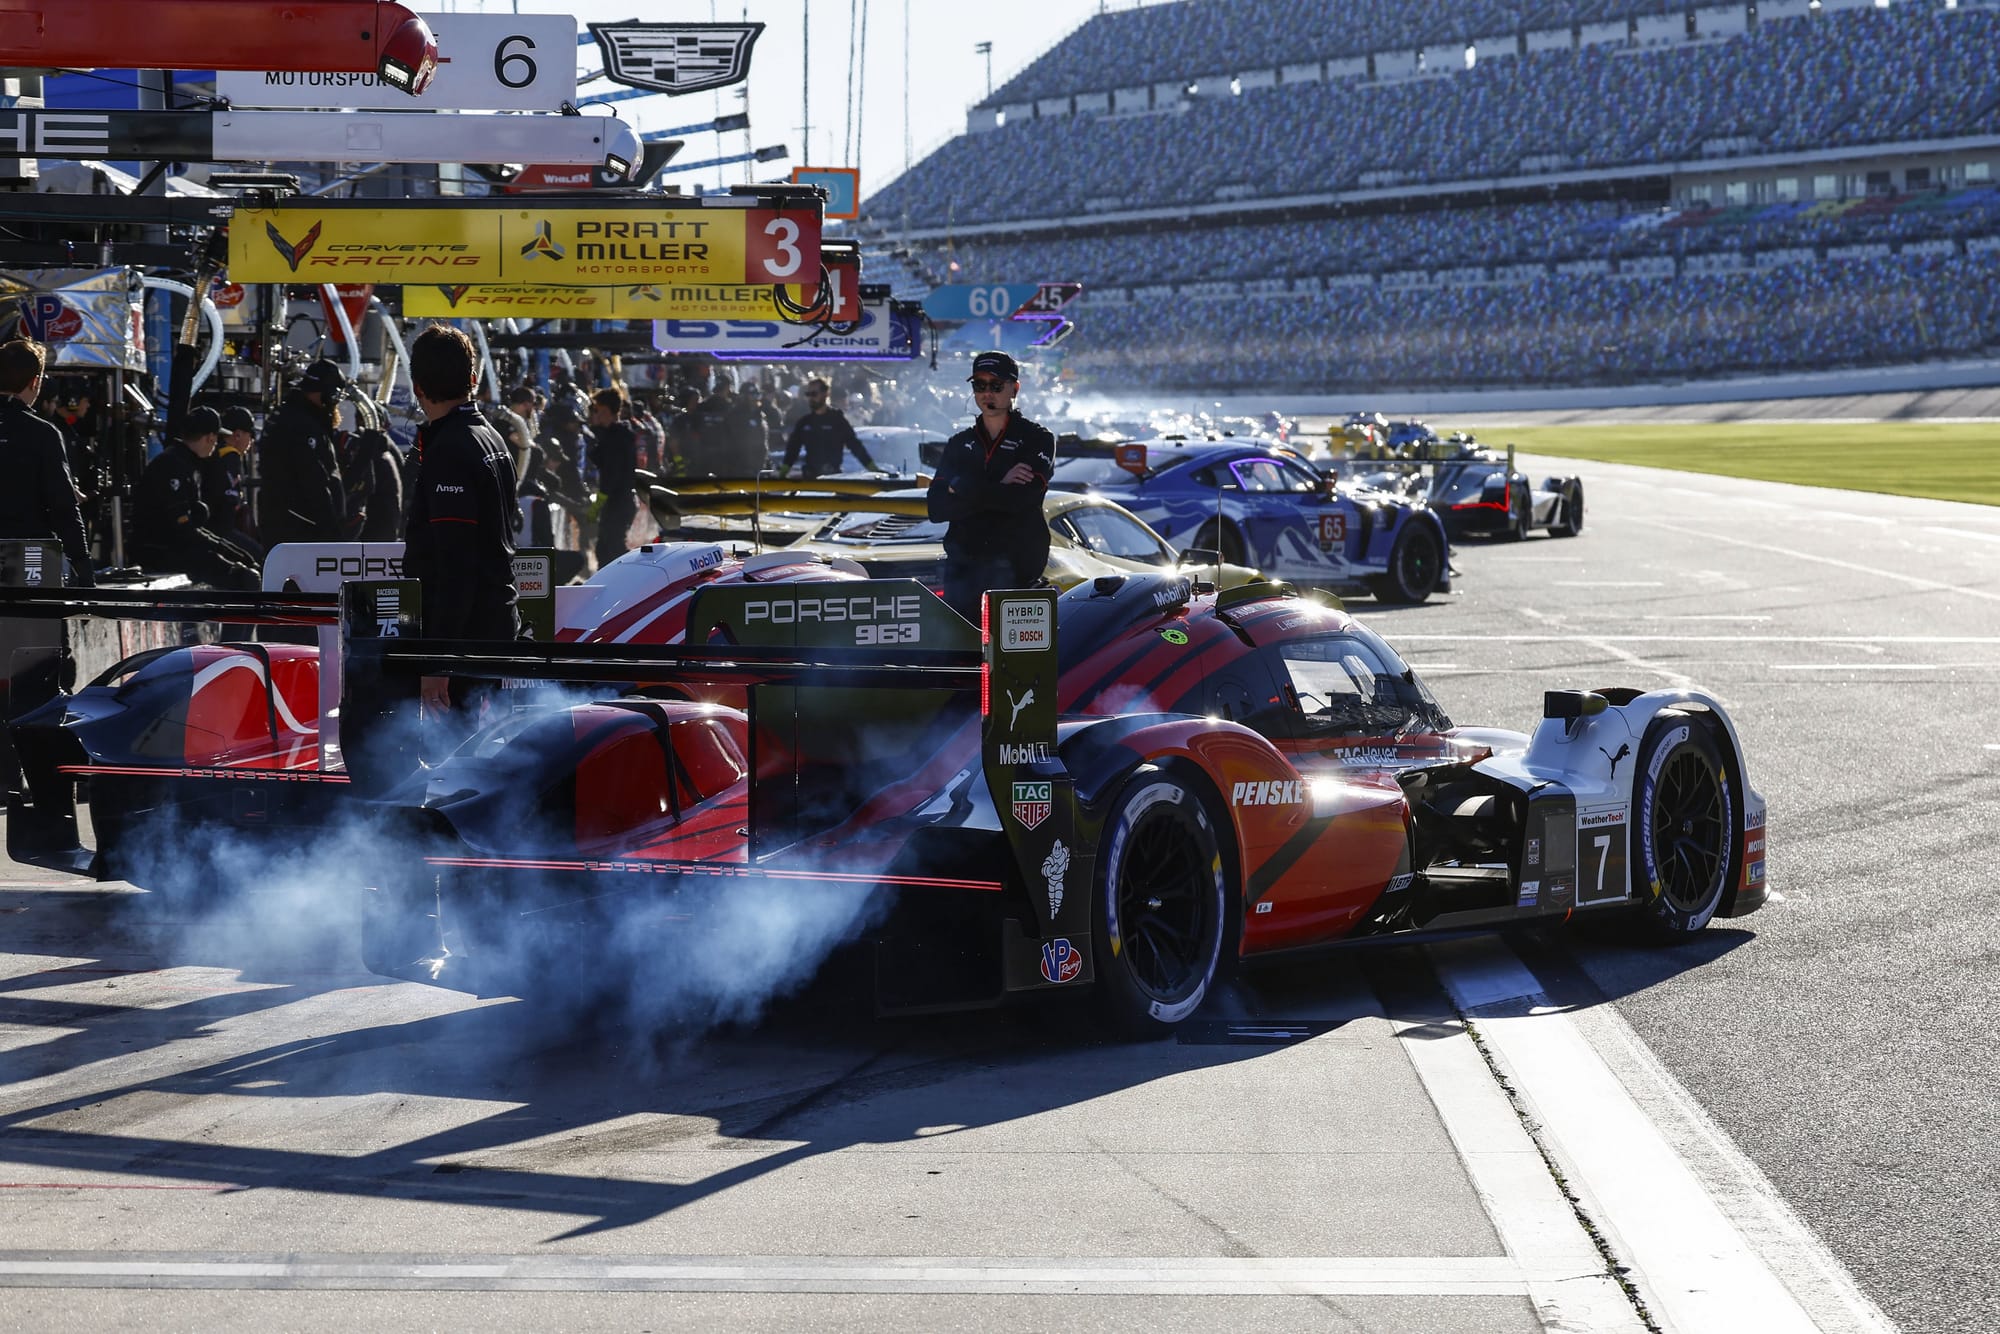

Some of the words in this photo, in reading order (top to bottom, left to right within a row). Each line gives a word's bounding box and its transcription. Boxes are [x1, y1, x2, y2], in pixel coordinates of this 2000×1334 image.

[494, 35, 537, 88] 6
[543, 173, 590, 184] WHELEN
[577, 222, 709, 239] PRATT
[327, 244, 469, 252] CORVETTE
[577, 243, 708, 260] MILLER
[763, 218, 801, 277] 3
[310, 256, 480, 266] RACING
[577, 265, 709, 274] MOTORSPORTS
[479, 287, 589, 295] CORVETTE
[671, 288, 772, 301] MILLER
[812, 269, 846, 314] 4
[1033, 287, 1063, 310] 45
[465, 296, 597, 306] RACING
[671, 304, 774, 312] MOTORSPORTS
[968, 287, 1010, 317] 60
[19, 295, 63, 342] VP
[436, 484, 464, 493] Ansys
[1324, 517, 1342, 539] 65
[689, 553, 714, 572] Mobil
[25, 567, 42, 580] 75
[520, 582, 542, 591] BOSCH
[1153, 585, 1182, 607] Mobil
[745, 596, 921, 625] PORSCHE
[1007, 604, 1044, 616] HYBRID
[377, 618, 399, 638] 75
[856, 623, 921, 645] 963
[1019, 631, 1043, 642] BOSCH
[1681, 727, 1687, 740] S
[1000, 743, 1037, 765] Mobil
[182, 768, 320, 781] PORSCHE
[1015, 785, 1049, 800] TAG
[1232, 780, 1303, 807] PENSKE
[1014, 803, 1049, 827] HEUER
[1581, 811, 1625, 826] WeatherTech
[1643, 785, 1653, 868] MICHELIN
[584, 860, 764, 878] PORSCHE
[1594, 834, 1611, 891] 7
[1042, 938, 1072, 982] VP
[1061, 960, 1080, 976] Racing
